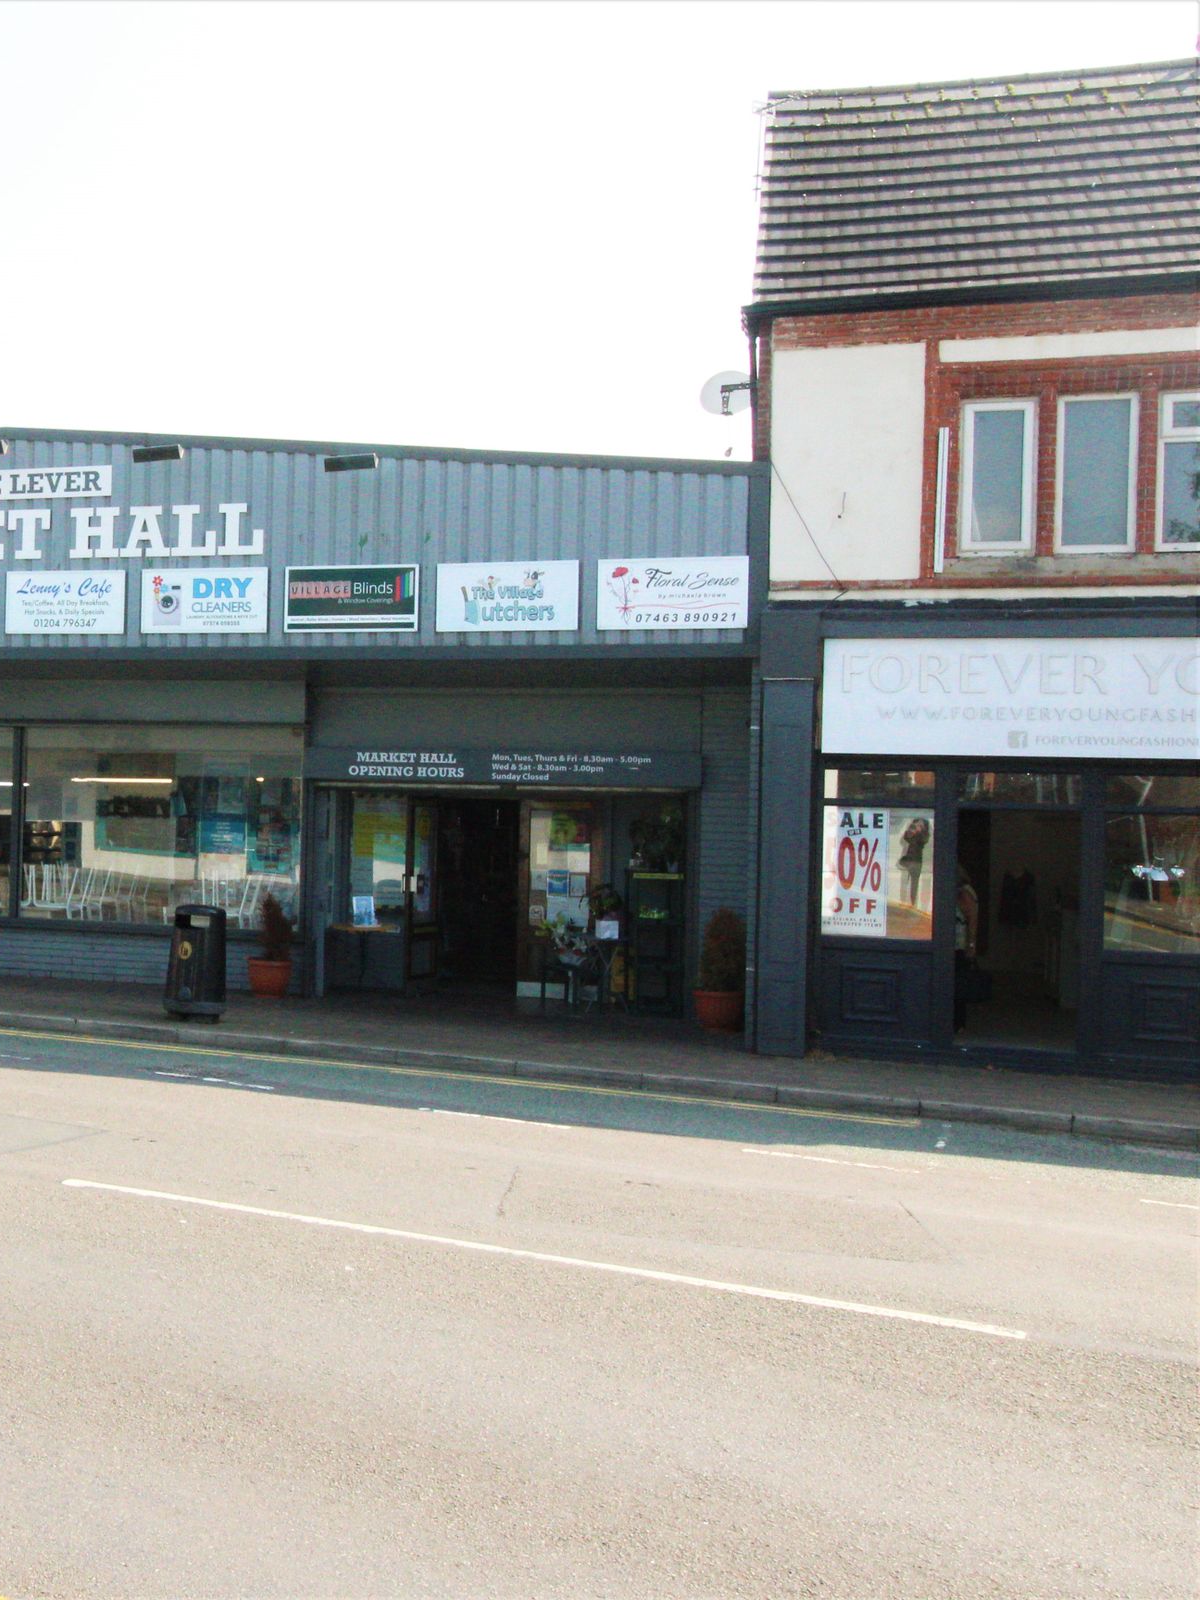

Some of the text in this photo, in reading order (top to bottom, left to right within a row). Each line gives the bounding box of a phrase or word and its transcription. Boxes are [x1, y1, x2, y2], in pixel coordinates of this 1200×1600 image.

[9, 470, 102, 495] LEVER
[69, 503, 264, 559] HALL
[645, 568, 739, 590] Floral Sense
[16, 577, 112, 598] Lenny's Cafe
[192, 577, 254, 599] DRY
[291, 581, 393, 595] VILLAGE Blinds
[471, 585, 544, 600] The Village
[191, 601, 252, 613] CLEANERS
[33, 618, 97, 628] 01204 796347
[635, 612, 737, 623] 07463 890921
[841, 653, 1108, 695] FOREVER
[357, 752, 457, 764] MARKET HALL
[491, 754, 511, 762] Mon,
[513, 754, 533, 762] Tues,
[535, 754, 557, 762] Thurs
[583, 755, 613, 763] 8.30am
[620, 756, 651, 765] 5.00pm
[348, 765, 464, 777] OPENING HOURS
[537, 764, 567, 772] 8.30am
[573, 765, 604, 773] 3.00pm
[491, 773, 521, 781] Sunday
[827, 812, 884, 828] ALE
[823, 836, 882, 892] 0%
[831, 897, 877, 914] OFF
